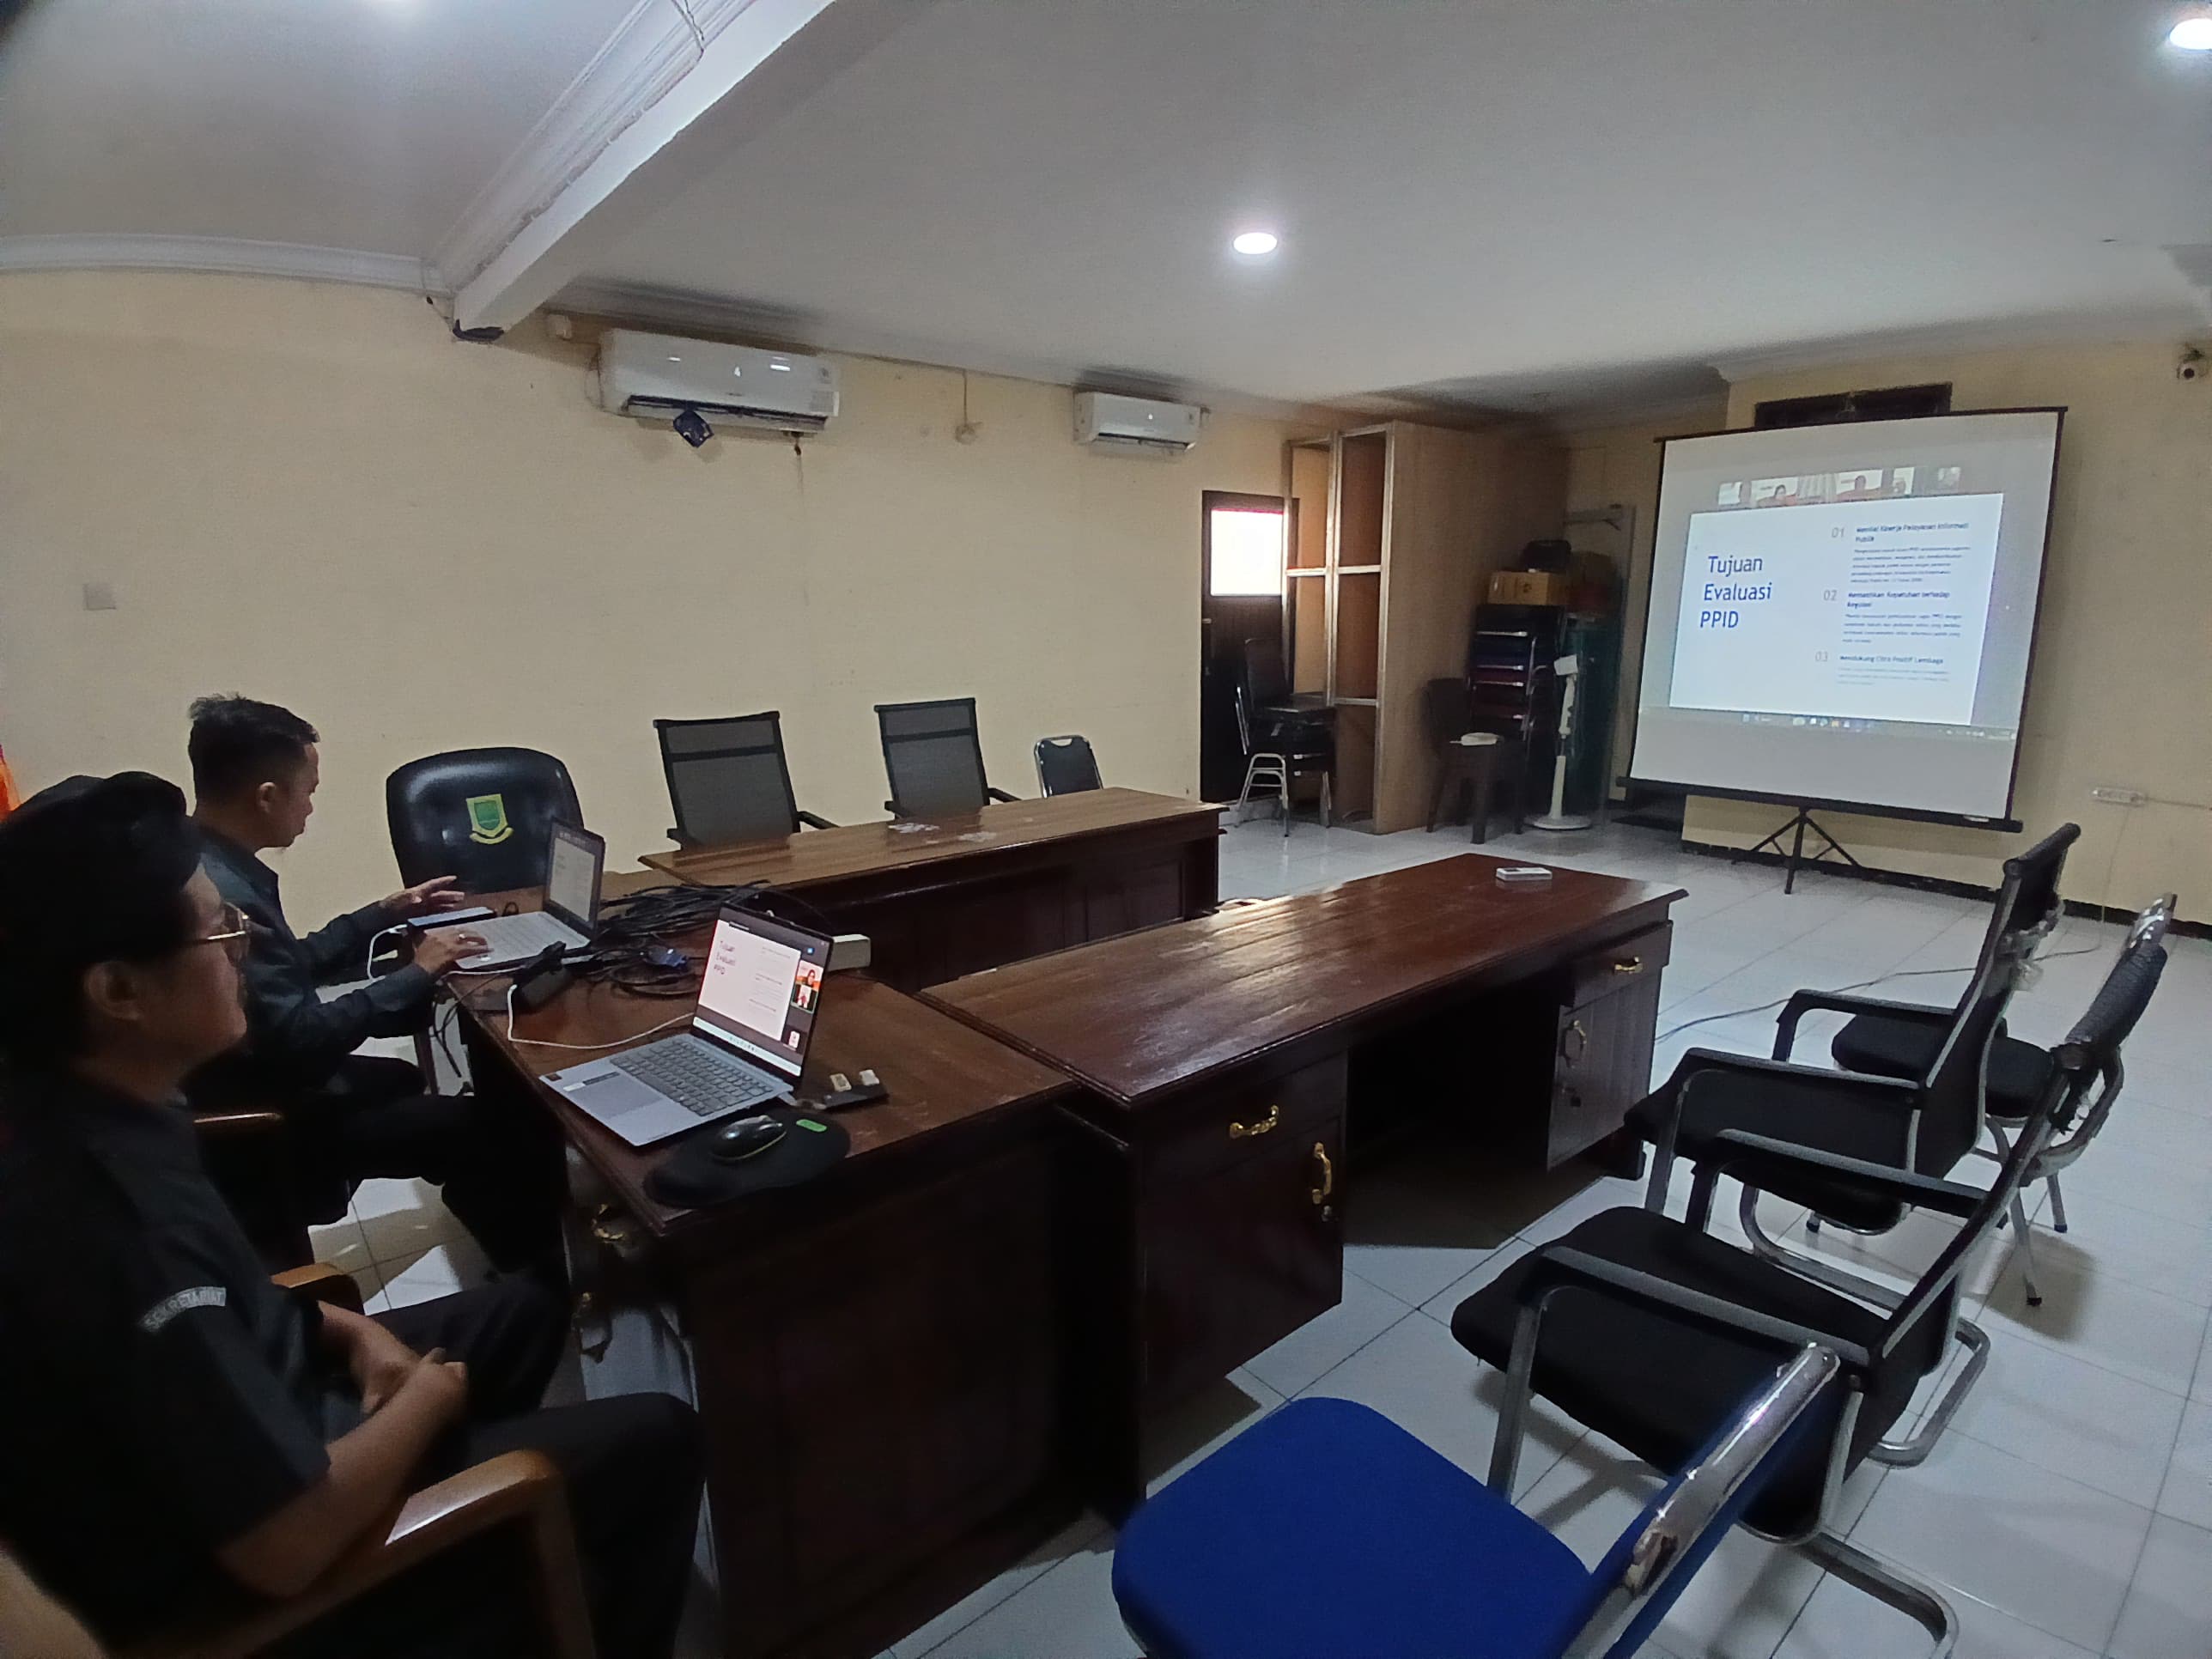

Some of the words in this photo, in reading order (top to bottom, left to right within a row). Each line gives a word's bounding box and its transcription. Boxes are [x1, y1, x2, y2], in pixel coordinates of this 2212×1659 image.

[1831, 526, 1845, 538] 01
[1708, 555, 1763, 577] Tujuan
[1704, 581, 1772, 601] Evaluasi
[1823, 589, 1838, 601] 02
[1699, 611, 1739, 628] PPID
